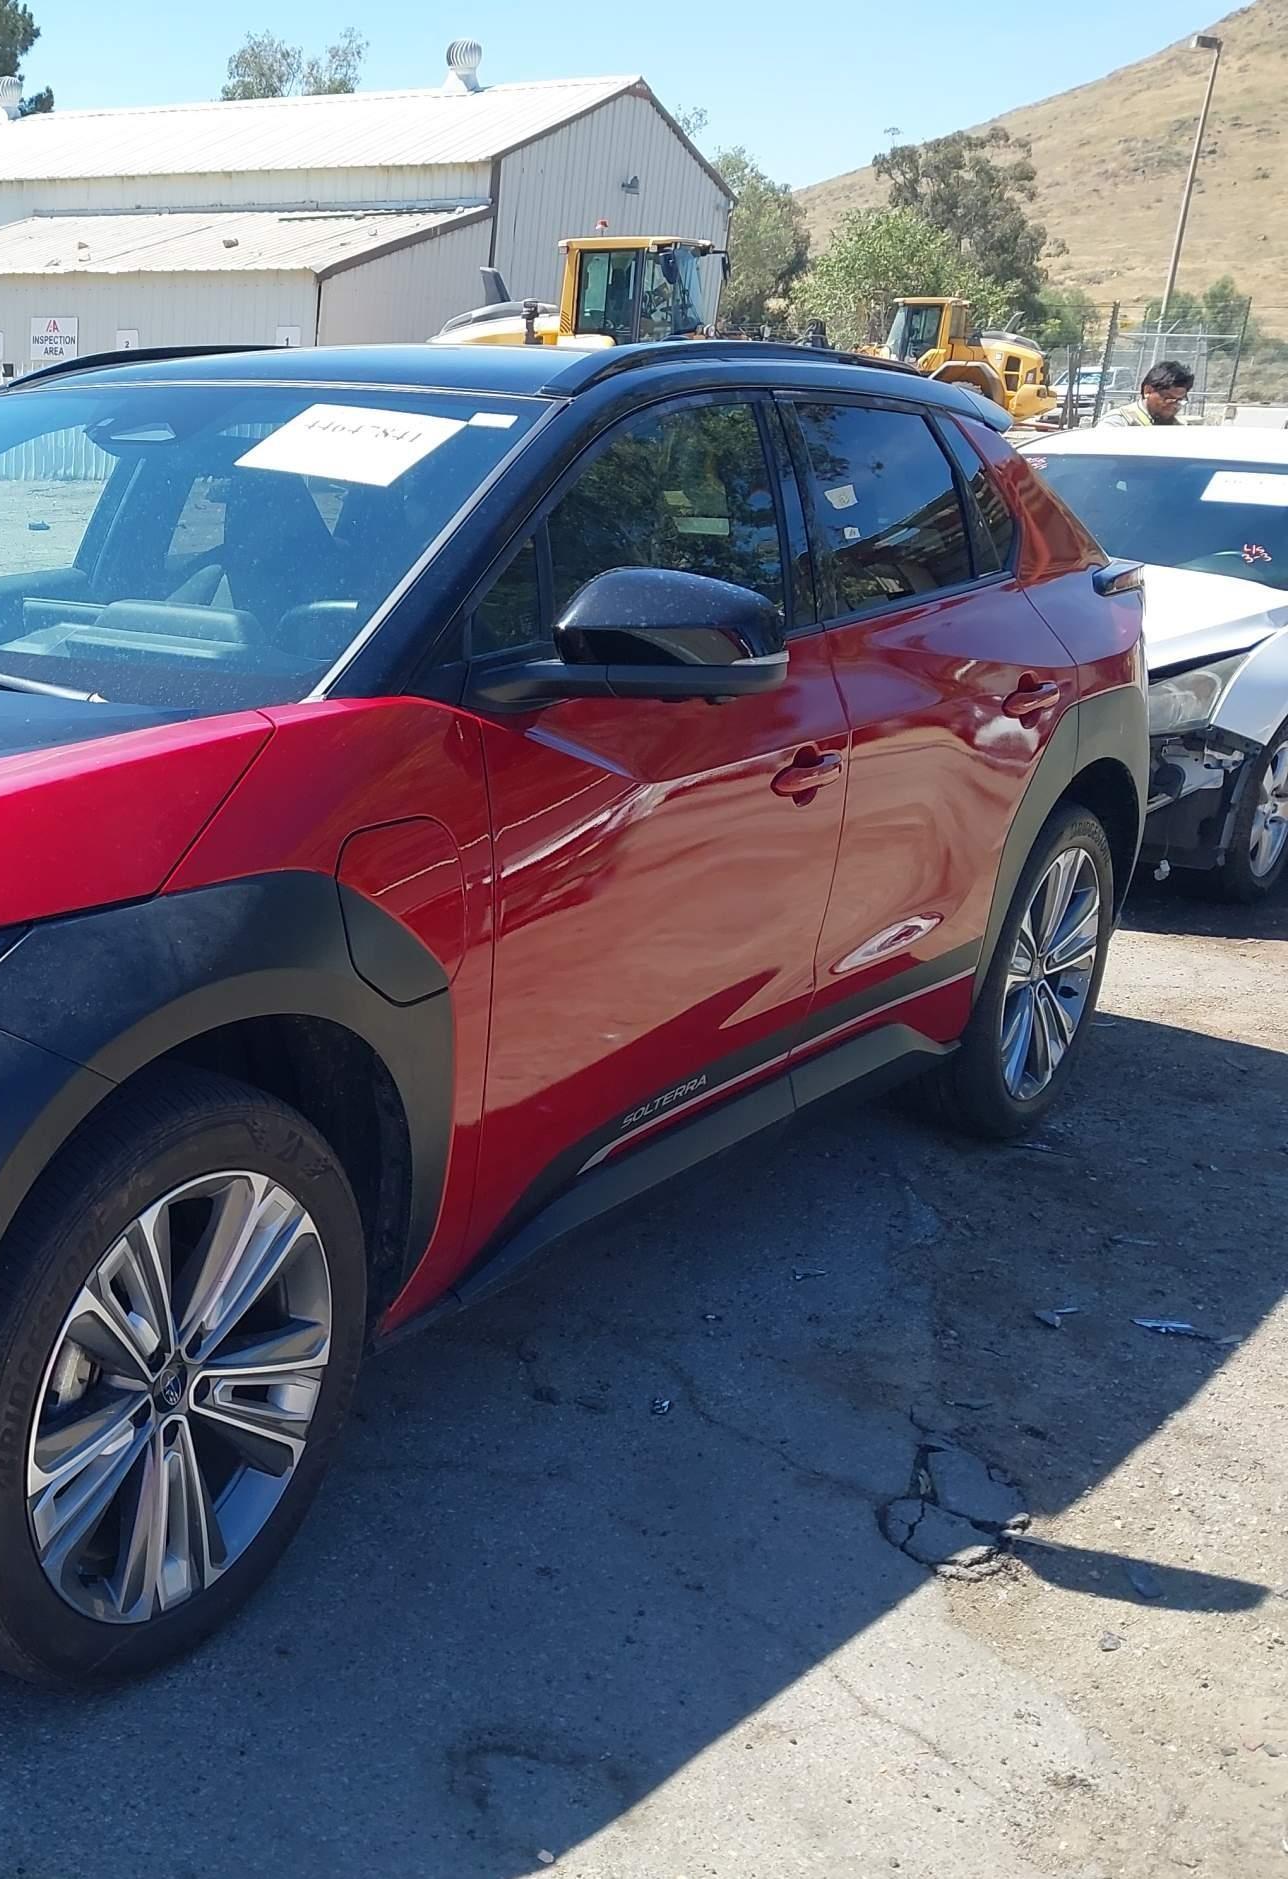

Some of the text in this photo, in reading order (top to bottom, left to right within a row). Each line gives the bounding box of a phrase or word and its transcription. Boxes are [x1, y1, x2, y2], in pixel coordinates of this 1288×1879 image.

[32, 335, 76, 345] INSPECTION
[124, 341, 130, 349] 2
[43, 346, 64, 356] AREA
[620, 1074, 706, 1129] SOLTERRA
